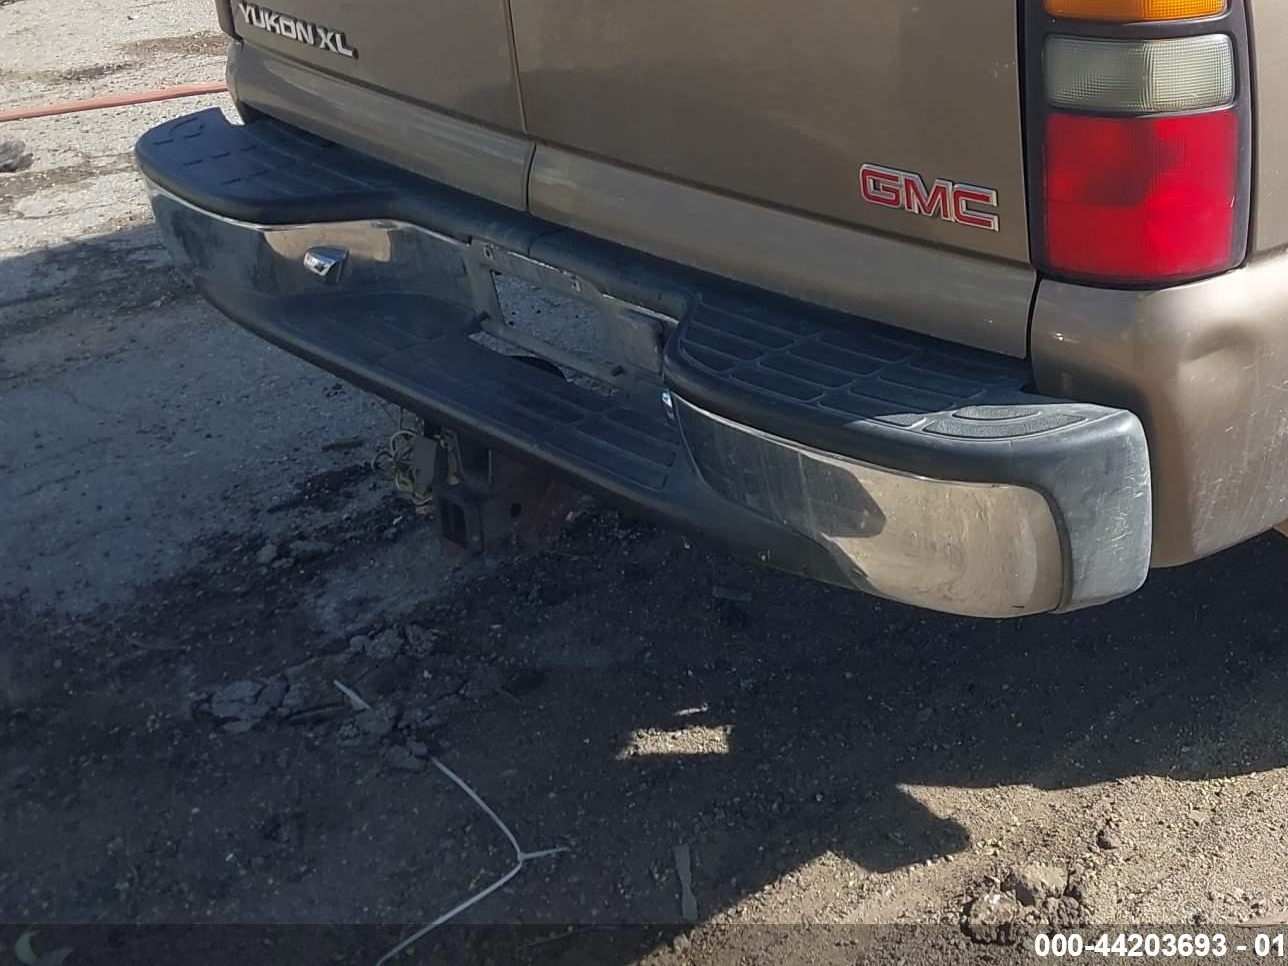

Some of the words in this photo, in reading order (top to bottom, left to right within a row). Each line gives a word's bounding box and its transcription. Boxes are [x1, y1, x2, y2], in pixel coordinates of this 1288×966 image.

[238, 1, 315, 46] YUKON
[316, 26, 357, 59] XL
[859, 163, 1000, 232] GMC
